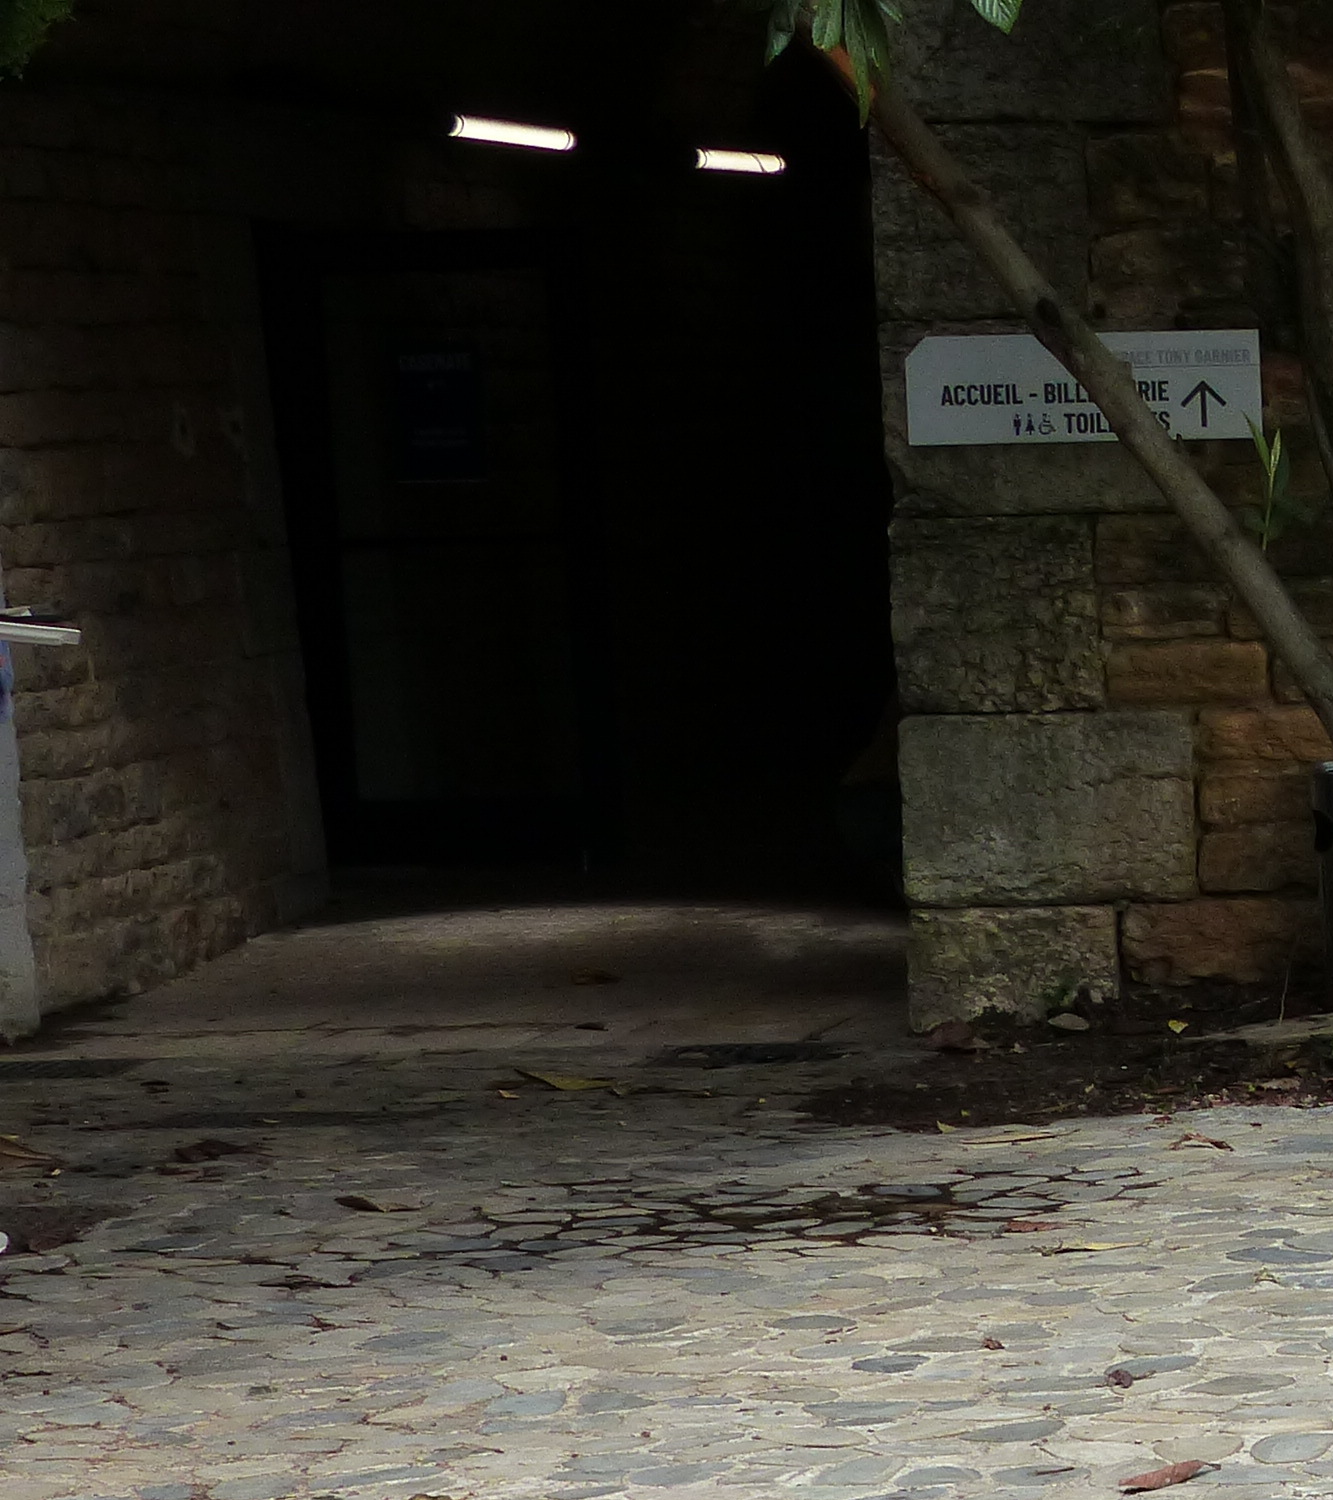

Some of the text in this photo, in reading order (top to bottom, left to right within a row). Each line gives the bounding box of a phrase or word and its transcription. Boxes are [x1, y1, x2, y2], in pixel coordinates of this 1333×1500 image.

[1194, 348, 1250, 363] GARNIER
[941, 383, 1023, 406] ACCUEIL
[1044, 381, 1169, 404] BILLRIE
[1063, 411, 1170, 434] TOILS
